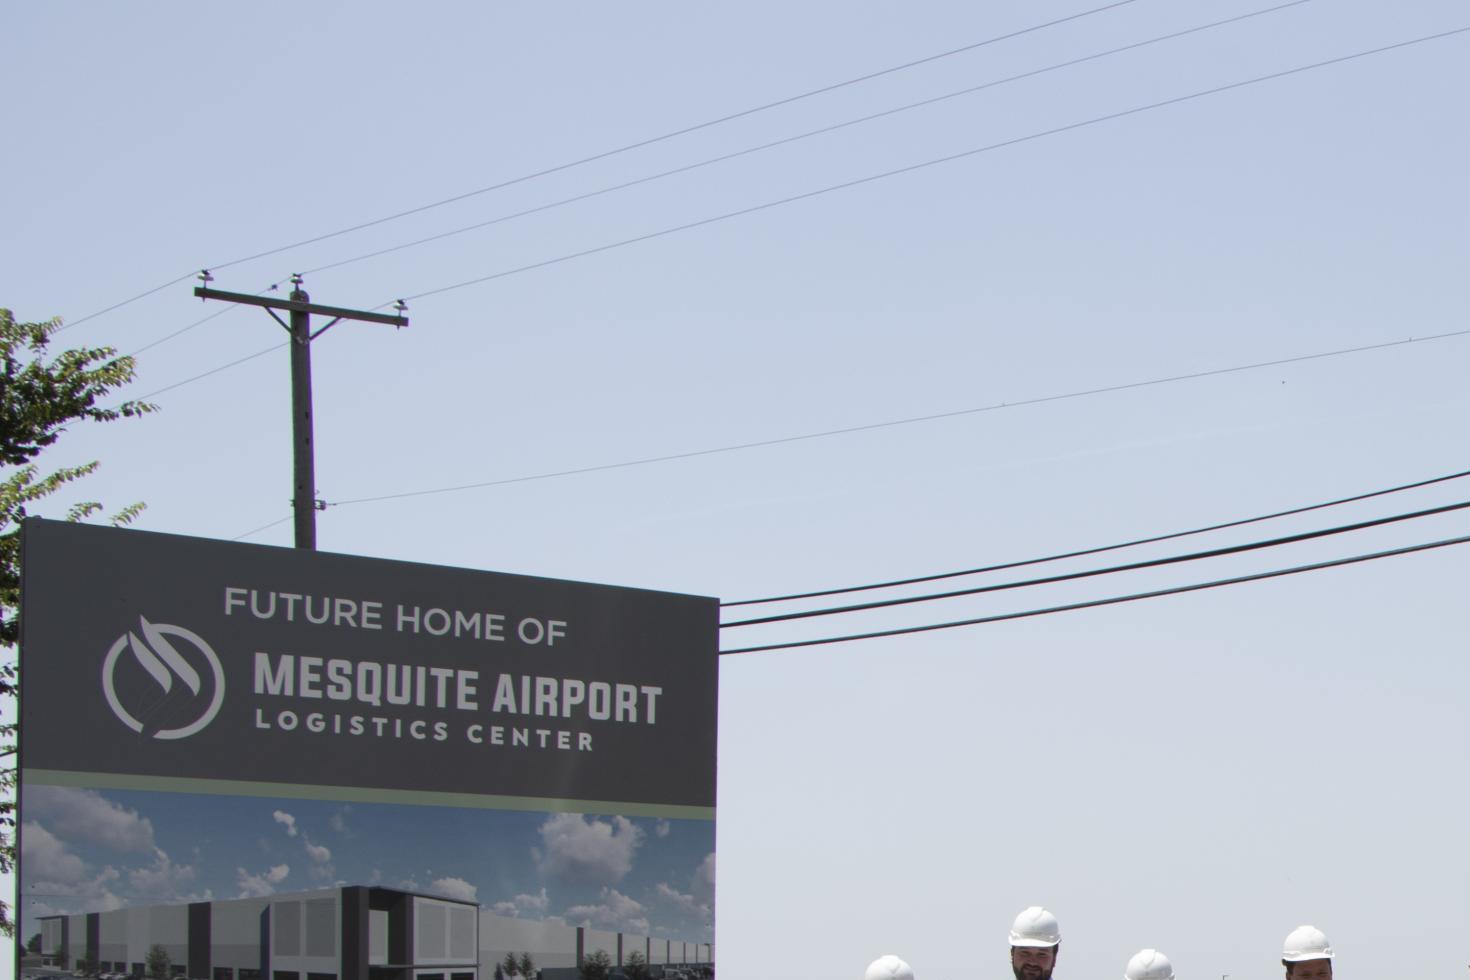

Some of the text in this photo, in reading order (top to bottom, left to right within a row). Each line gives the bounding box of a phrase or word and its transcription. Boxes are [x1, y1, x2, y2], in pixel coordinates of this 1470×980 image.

[224, 586, 568, 646] FUTURE HOME OF
[254, 652, 663, 725] MESQUITE AIRPORT
[255, 708, 595, 752] LOGISTICS CENTER
